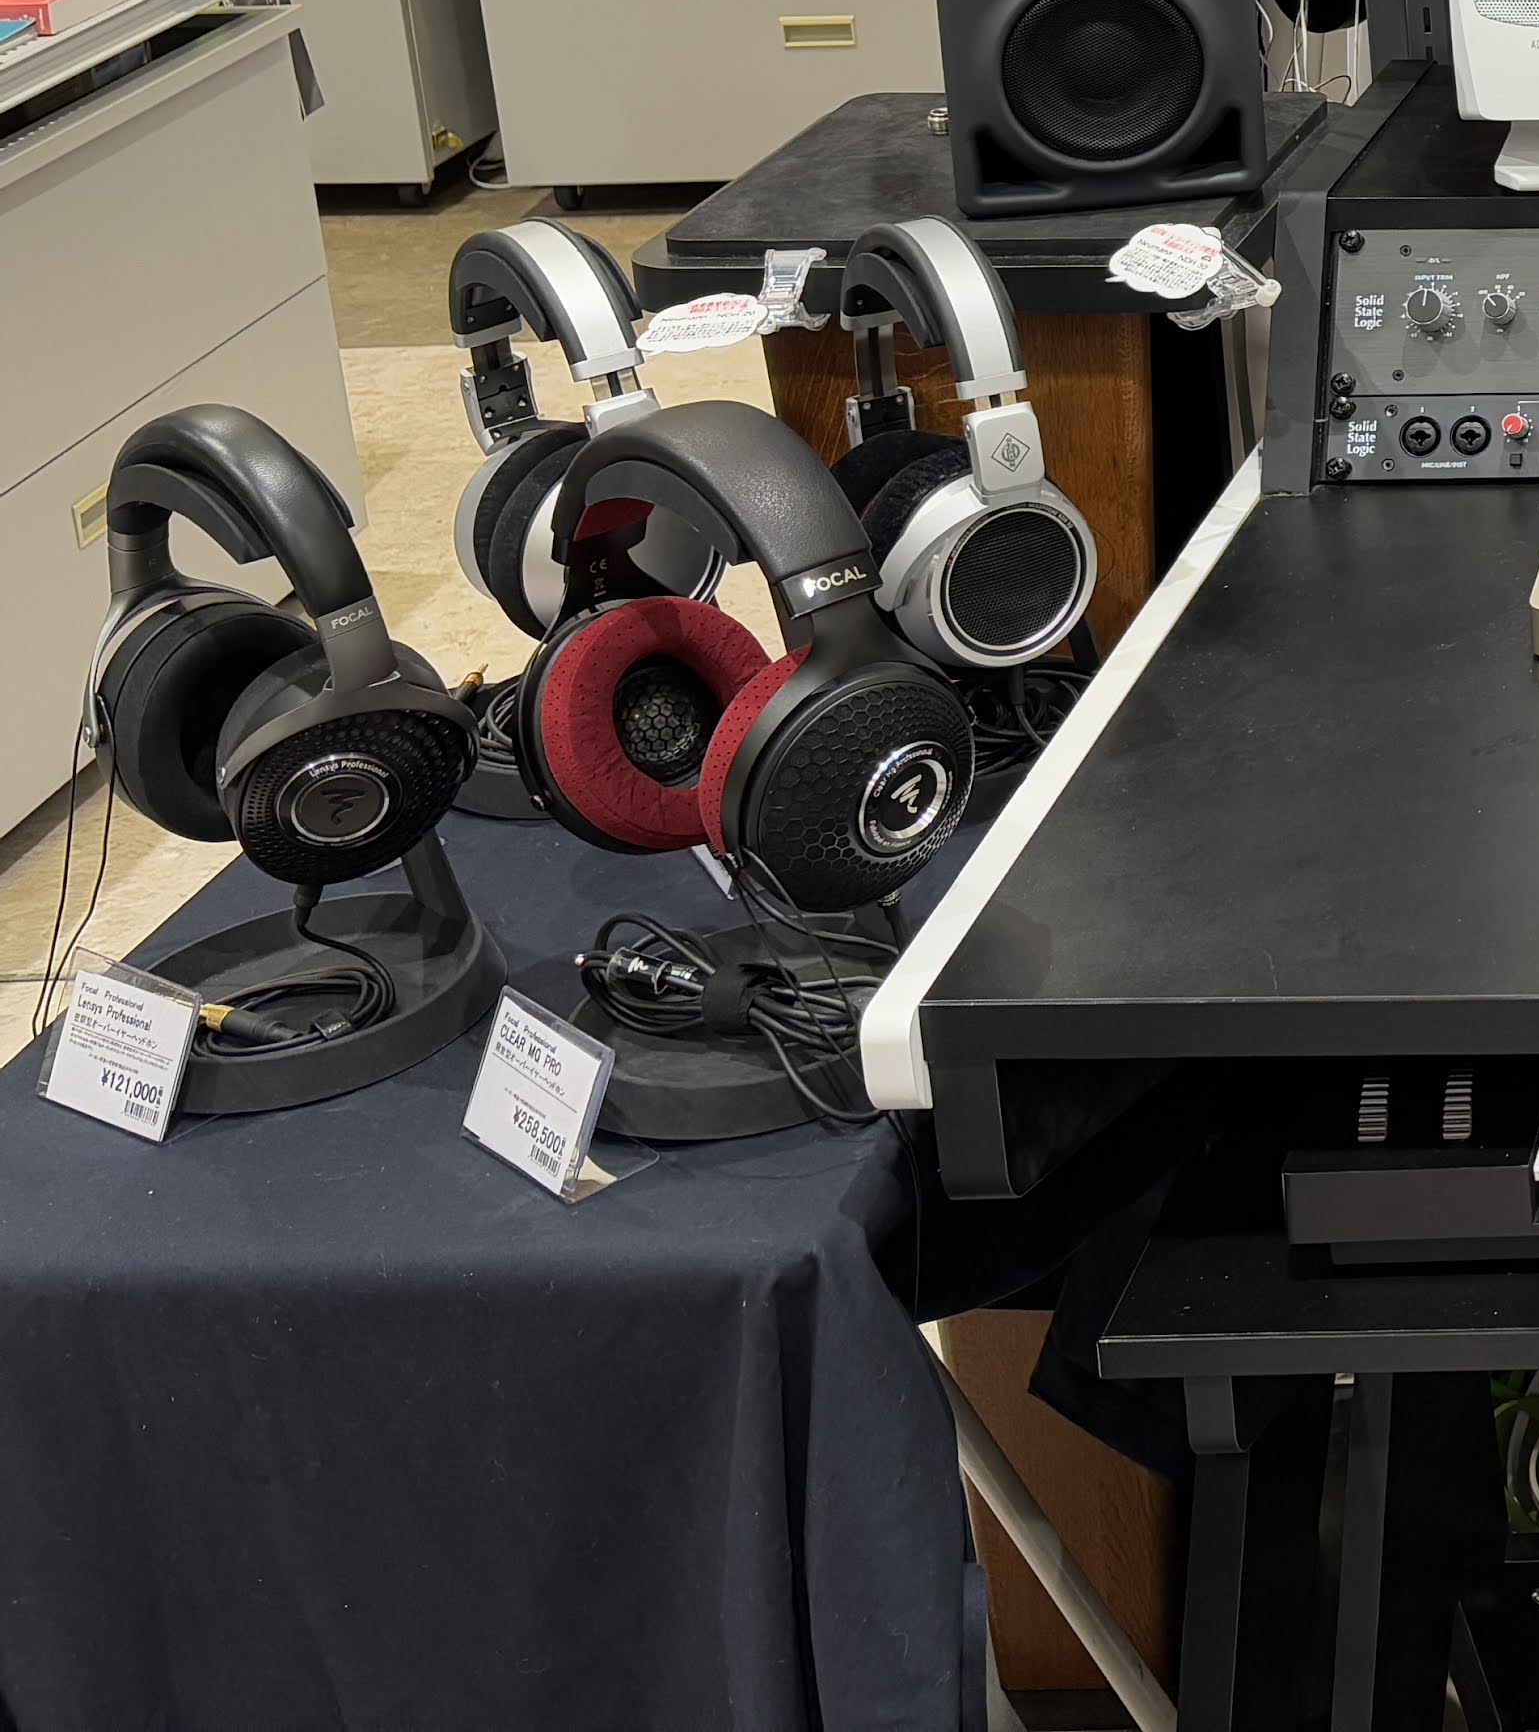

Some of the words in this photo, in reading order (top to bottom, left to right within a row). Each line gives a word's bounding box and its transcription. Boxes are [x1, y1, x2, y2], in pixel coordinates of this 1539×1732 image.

[1356, 295, 1384, 306] Solid
[1355, 306, 1383, 317] State
[1354, 317, 1383, 330] Logic
[1348, 421, 1377, 433] Solid
[1347, 433, 1376, 444] State
[1346, 444, 1375, 457] Logic
[803, 568, 867, 597] FOCAL
[331, 607, 374, 630] FOCAL
[81, 982, 99, 996] Focal
[104, 990, 145, 1012] Professional
[78, 995, 102, 1015] Lensys
[106, 1005, 152, 1032] Professional
[500, 1025, 525, 1052] CLEAR
[544, 1054, 562, 1077] PRO
